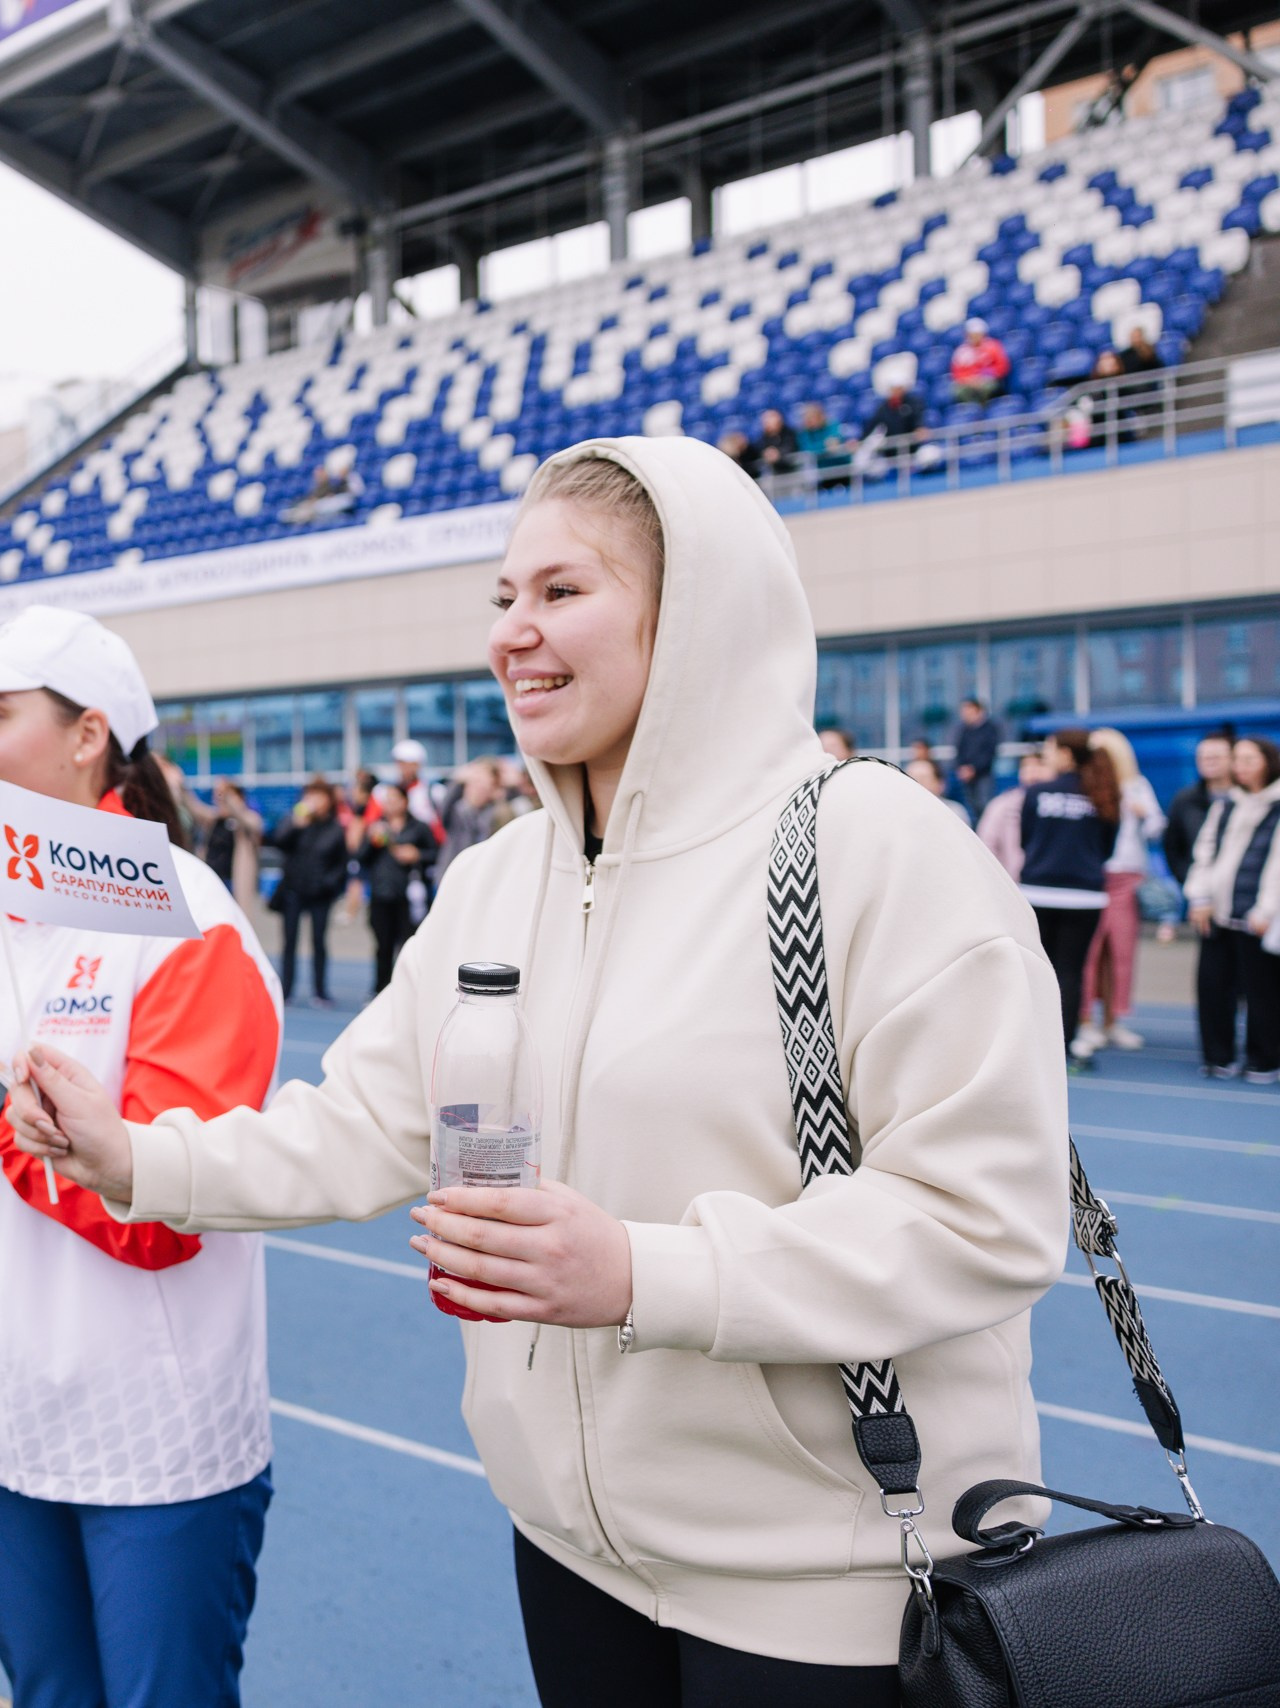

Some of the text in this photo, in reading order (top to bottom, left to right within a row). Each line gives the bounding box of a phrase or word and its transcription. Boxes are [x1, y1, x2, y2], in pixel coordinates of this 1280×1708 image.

[49, 840, 164, 885] КОМОС
[51, 871, 171, 902] САРАПУЛЬСКИЙ
[53, 886, 172, 912] МЯСОКОМБИНАТ
